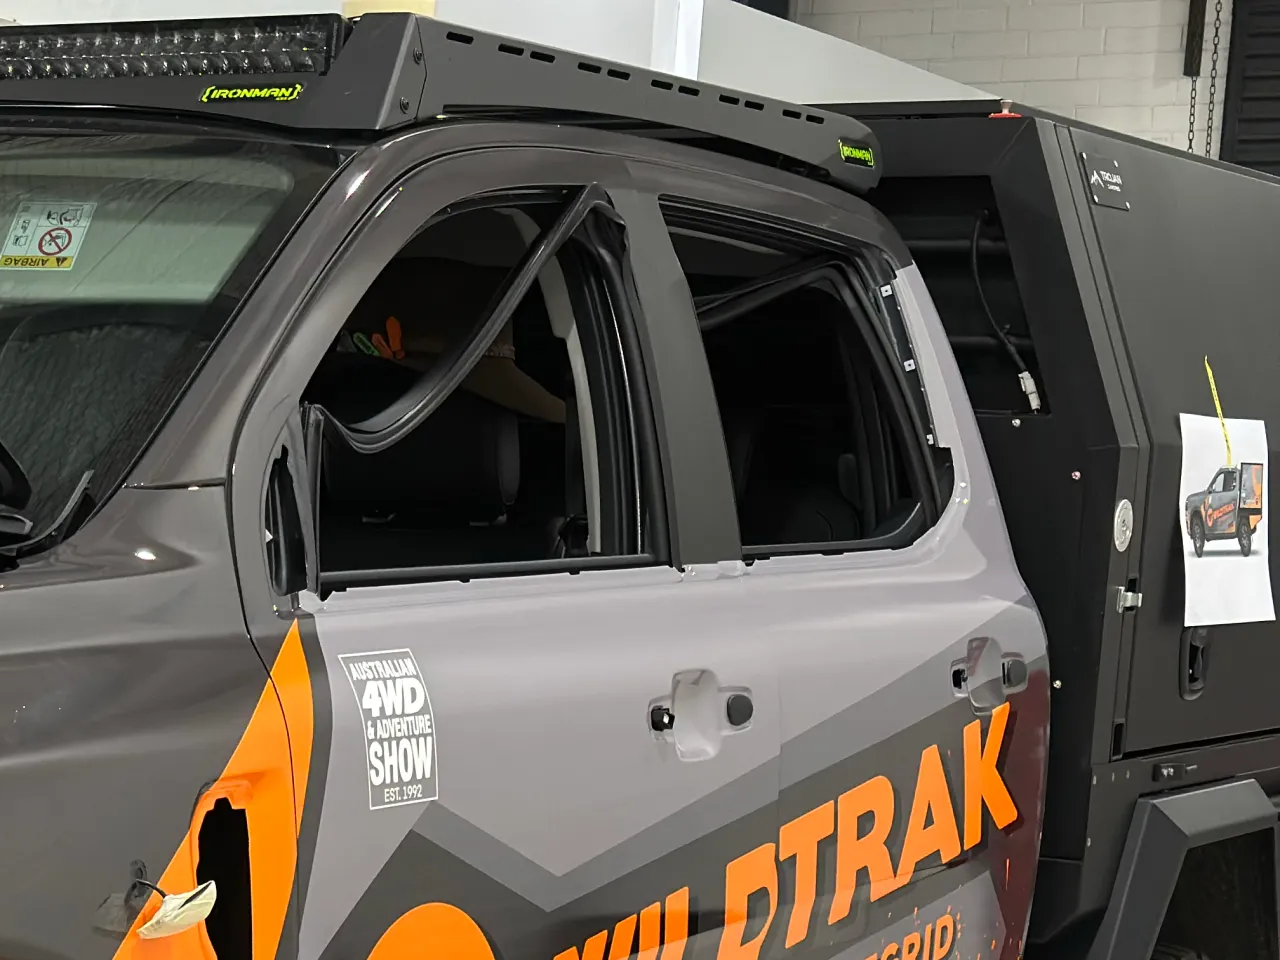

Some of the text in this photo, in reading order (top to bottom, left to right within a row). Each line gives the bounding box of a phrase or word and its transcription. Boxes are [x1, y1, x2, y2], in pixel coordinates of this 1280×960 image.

[210, 87, 293, 99] IRONMAN
[4, 257, 50, 266] AIRBAG
[349, 658, 417, 680] AUSTRALIAN
[362, 677, 425, 717] 4WD
[367, 714, 432, 740] & ADVENTURE
[369, 735, 433, 786] SHOW
[384, 784, 422, 803] EST. 1992
